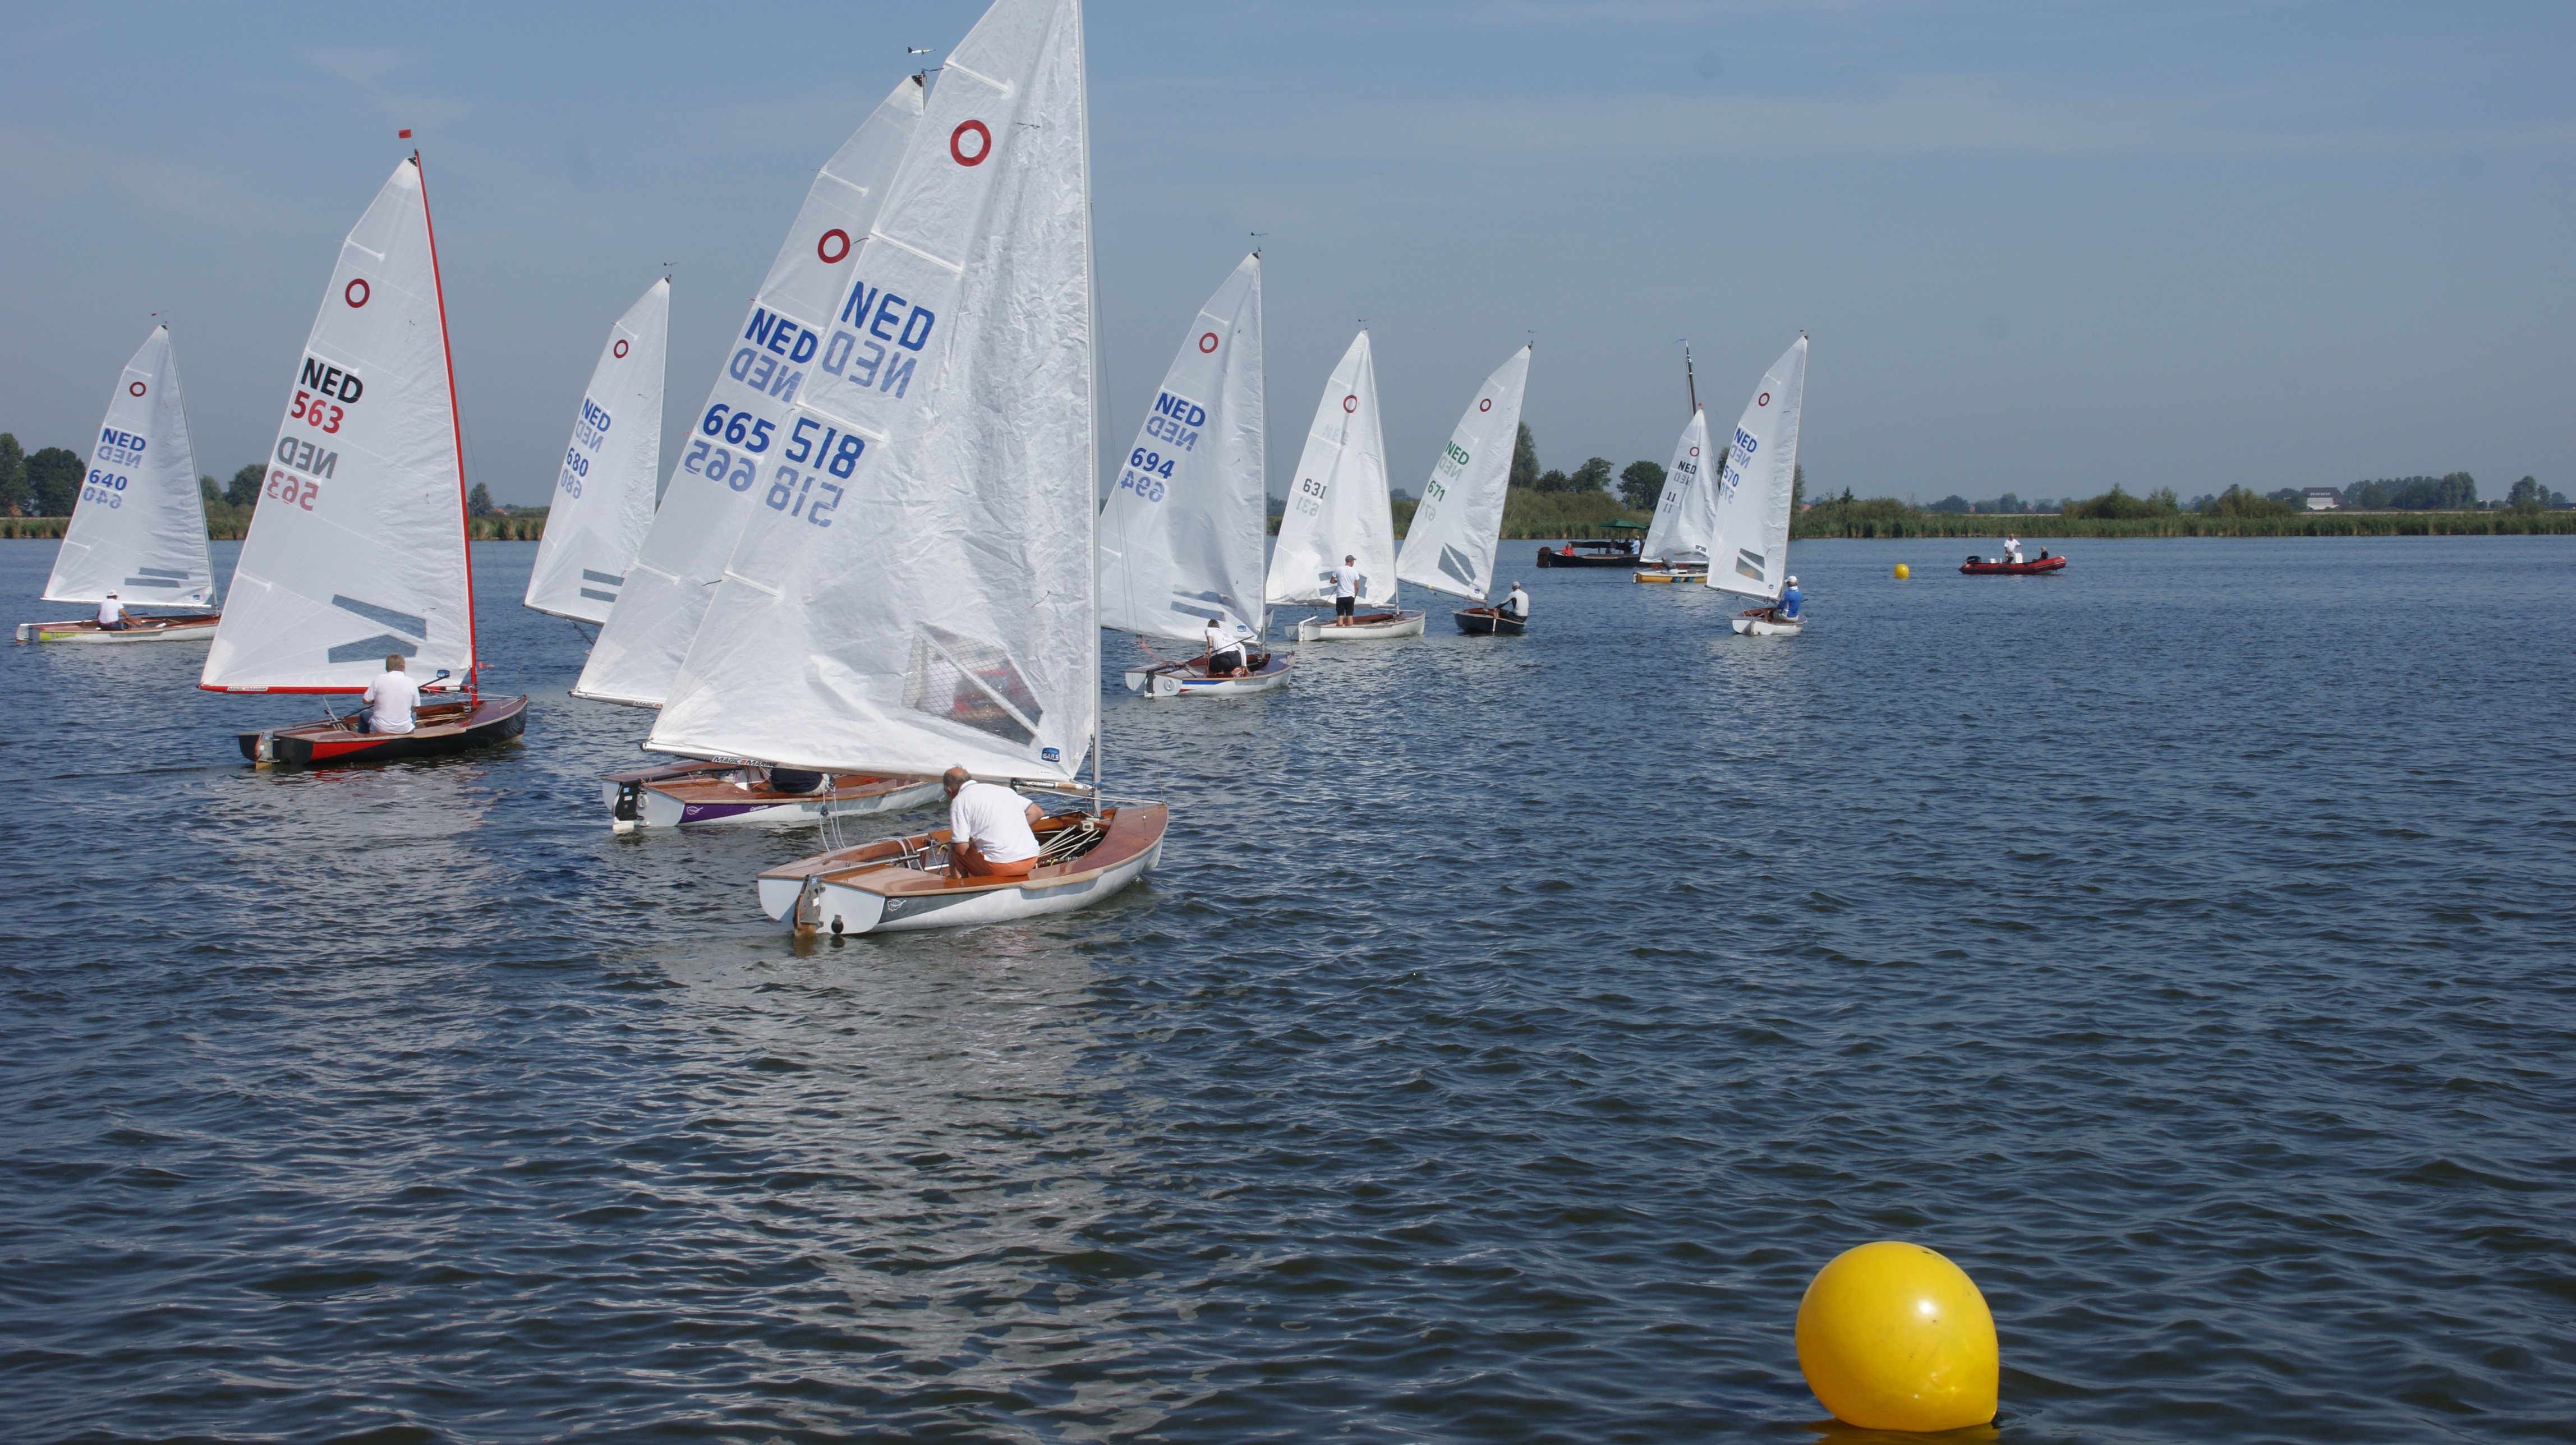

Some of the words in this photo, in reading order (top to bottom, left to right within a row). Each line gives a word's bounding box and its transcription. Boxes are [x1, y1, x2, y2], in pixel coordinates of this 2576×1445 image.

[840, 281, 935, 351] NED
[744, 307, 818, 363] NED
[300, 357, 364, 404] NED
[291, 390, 344, 434] 563
[581, 398, 611, 432] NED
[1154, 392, 1206, 427] NED
[102, 428, 146, 452] NED
[702, 403, 776, 453] 665
[1734, 427, 1757, 453] NED
[567, 447, 588, 477] 680
[785, 417, 865, 479] 518
[1130, 447, 1175, 479] 694
[1445, 440, 1469, 465] NED
[89, 469, 127, 491] 640
[1678, 461, 1696, 475] NED
[1723, 464, 1739, 487] 570
[1303, 478, 1327, 499] 631
[1428, 480, 1445, 502] 671
[1667, 491, 1676, 502] 11
